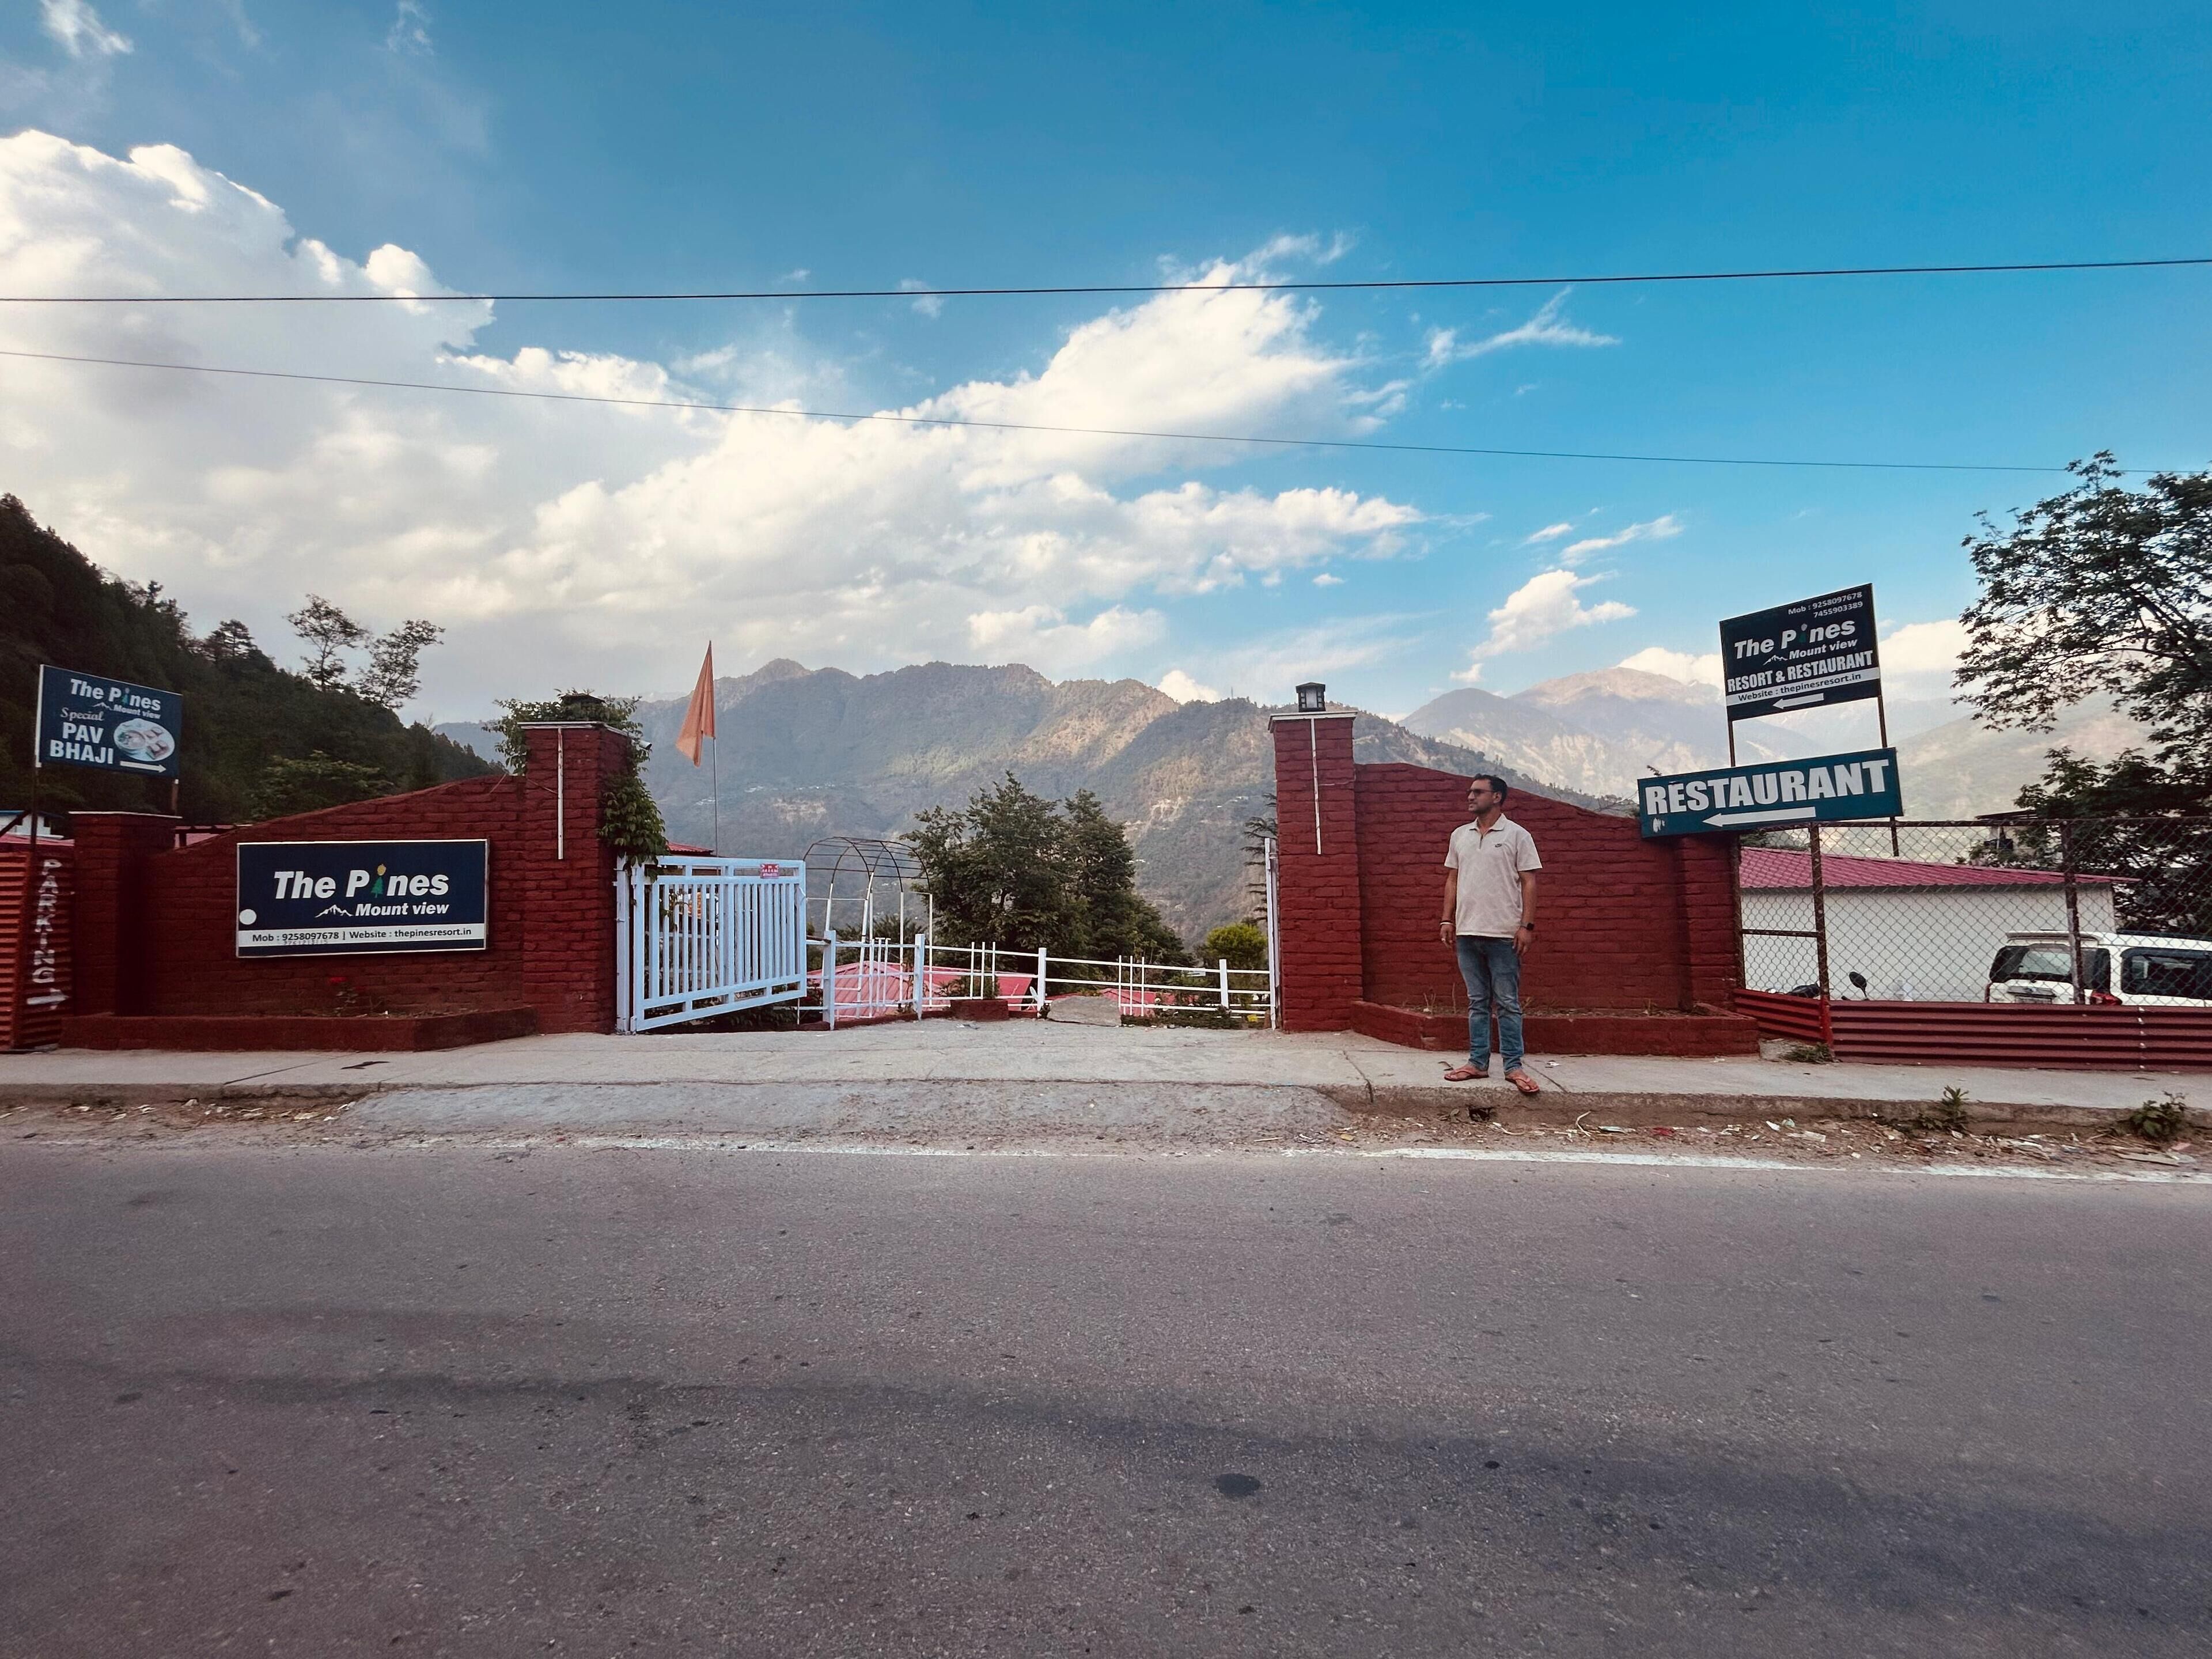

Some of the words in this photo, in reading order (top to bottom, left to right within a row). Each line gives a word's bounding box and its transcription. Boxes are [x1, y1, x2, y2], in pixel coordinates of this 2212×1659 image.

[1788, 606, 1806, 615] Mob
[1812, 592, 1862, 609] 9258097678
[1813, 601, 1863, 618] 7455903389
[1734, 637, 1774, 659] The
[1781, 619, 1856, 649] Pines
[1789, 645, 1827, 660] Mount
[1830, 639, 1858, 651] view
[1727, 670, 1773, 692] RESORT
[1775, 671, 1785, 683] &
[1787, 650, 1873, 680] RESTAURANT
[71, 678, 104, 699] The
[108, 687, 161, 711] Pines
[1738, 689, 1773, 702] Website
[1781, 672, 1861, 694] thepinesresort.in
[60, 707, 104, 721] Special
[113, 704, 141, 716] Mount
[143, 710, 161, 719] view
[63, 722, 104, 744] PAV
[50, 740, 113, 764] BHAJI
[1645, 759, 1889, 815] RESTAURANT
[274, 871, 336, 899] The
[346, 864, 449, 897] Pines
[32, 859, 62, 983] PARKING
[355, 903, 408, 916] Mount
[413, 903, 449, 915] view
[282, 932, 339, 941] 9258097678
[349, 930, 387, 938] Website
[395, 928, 471, 938] thepinesresort.in
